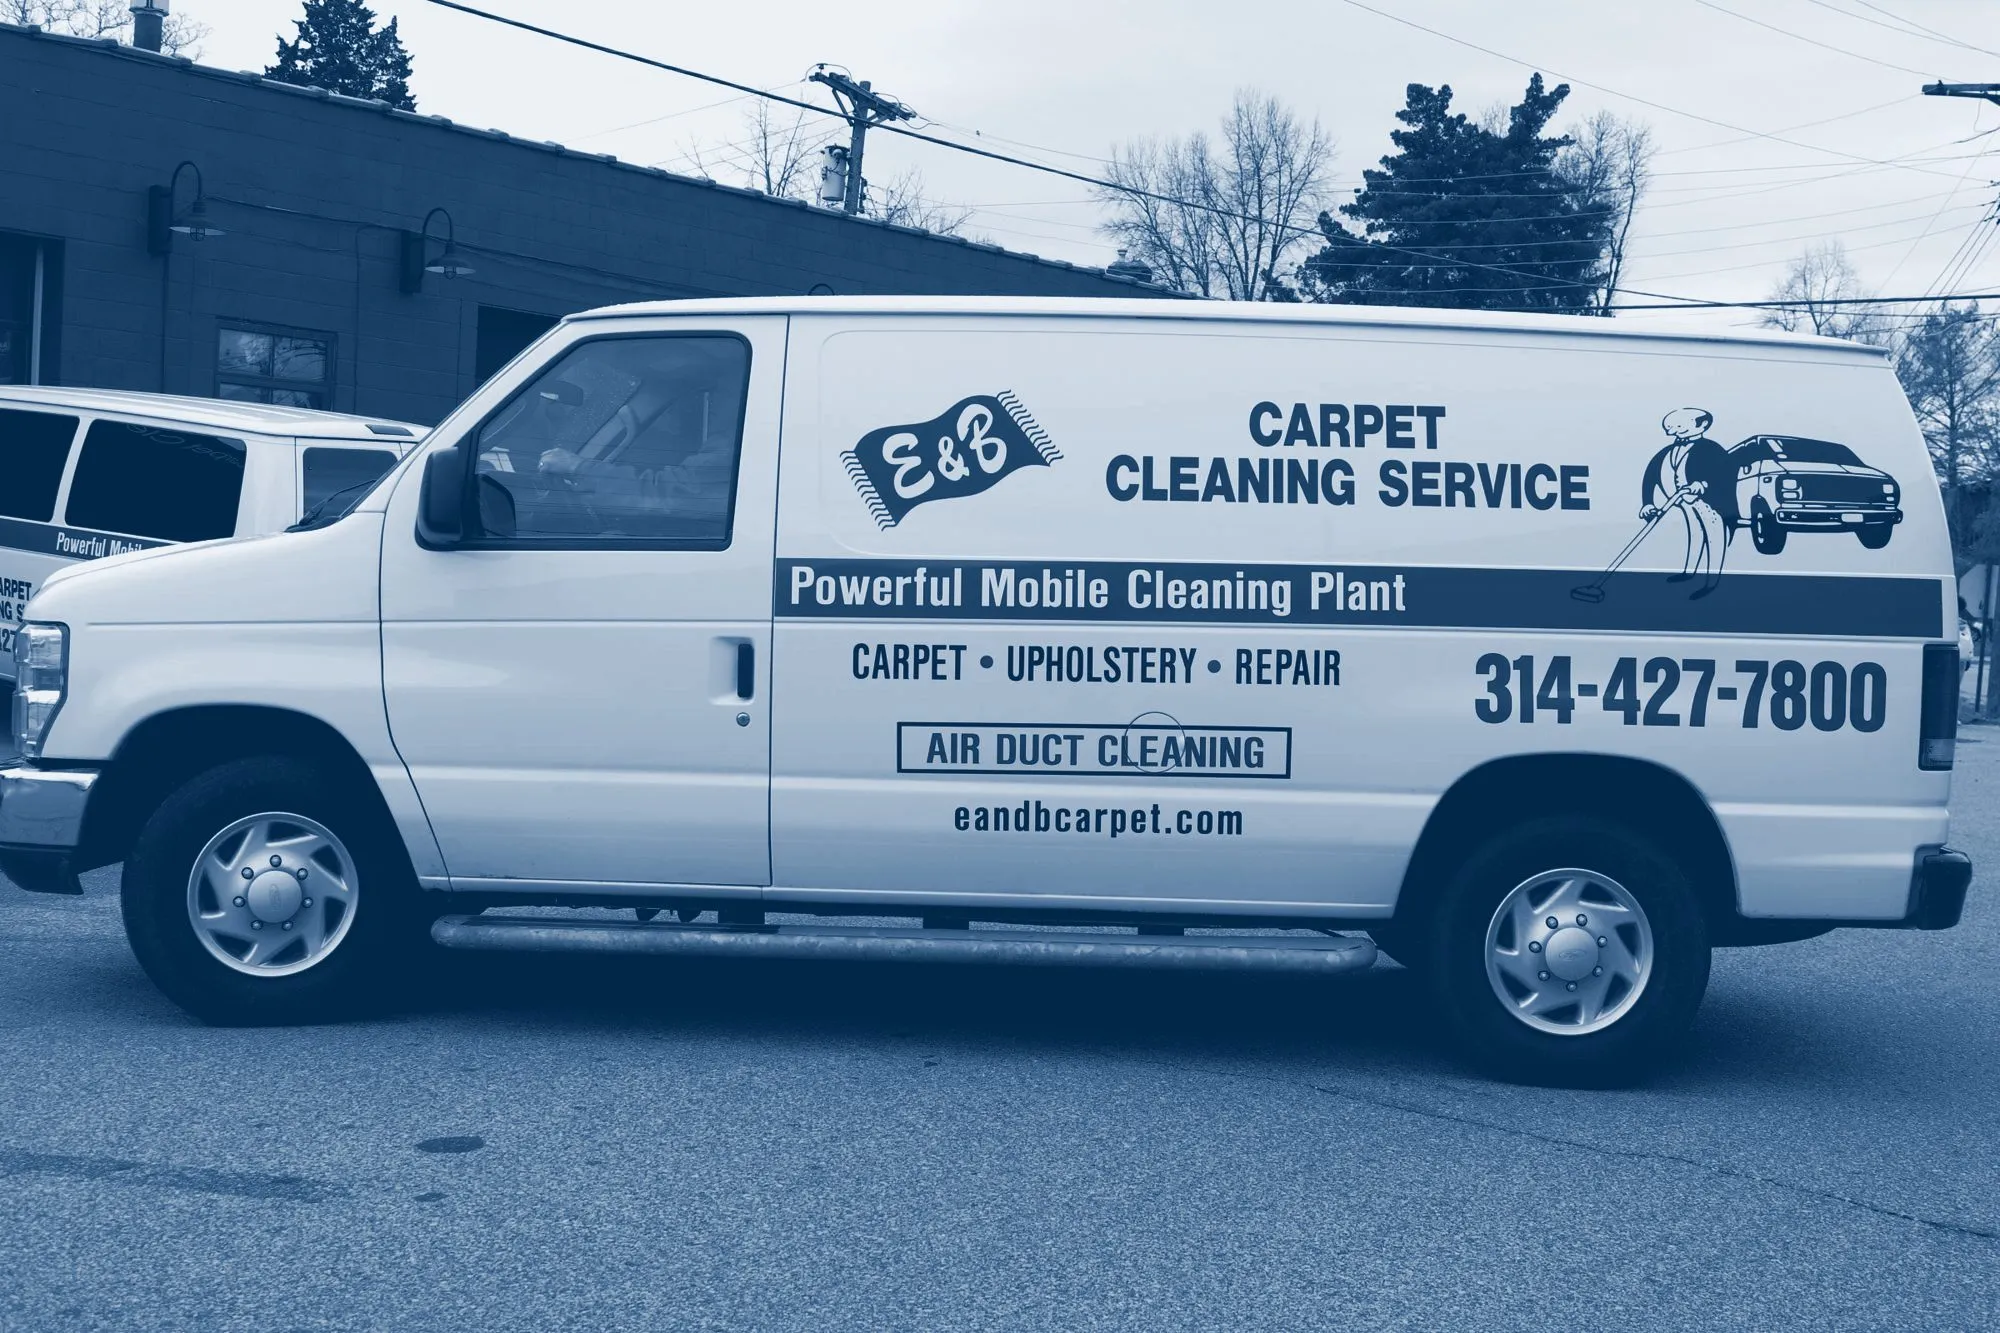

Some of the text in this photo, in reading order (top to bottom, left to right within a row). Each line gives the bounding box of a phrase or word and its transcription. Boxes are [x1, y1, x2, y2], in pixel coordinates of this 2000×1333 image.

[1249, 402, 1445, 449] CARPET
[882, 404, 1007, 498] E&B
[1106, 455, 1590, 510] CLEANING SERVICE
[56, 532, 106, 557] Powerful
[0, 577, 32, 601] ARPET
[792, 566, 1405, 616] Powerful Mobile Cleaning Plant
[853, 643, 1341, 685] CARPET UPHOLSTERY REPAIR
[1475, 653, 1887, 732] 314-427-7800
[926, 733, 1264, 768] AIR DUCT CLEANING
[955, 800, 1242, 838] eandbcarpet.com
